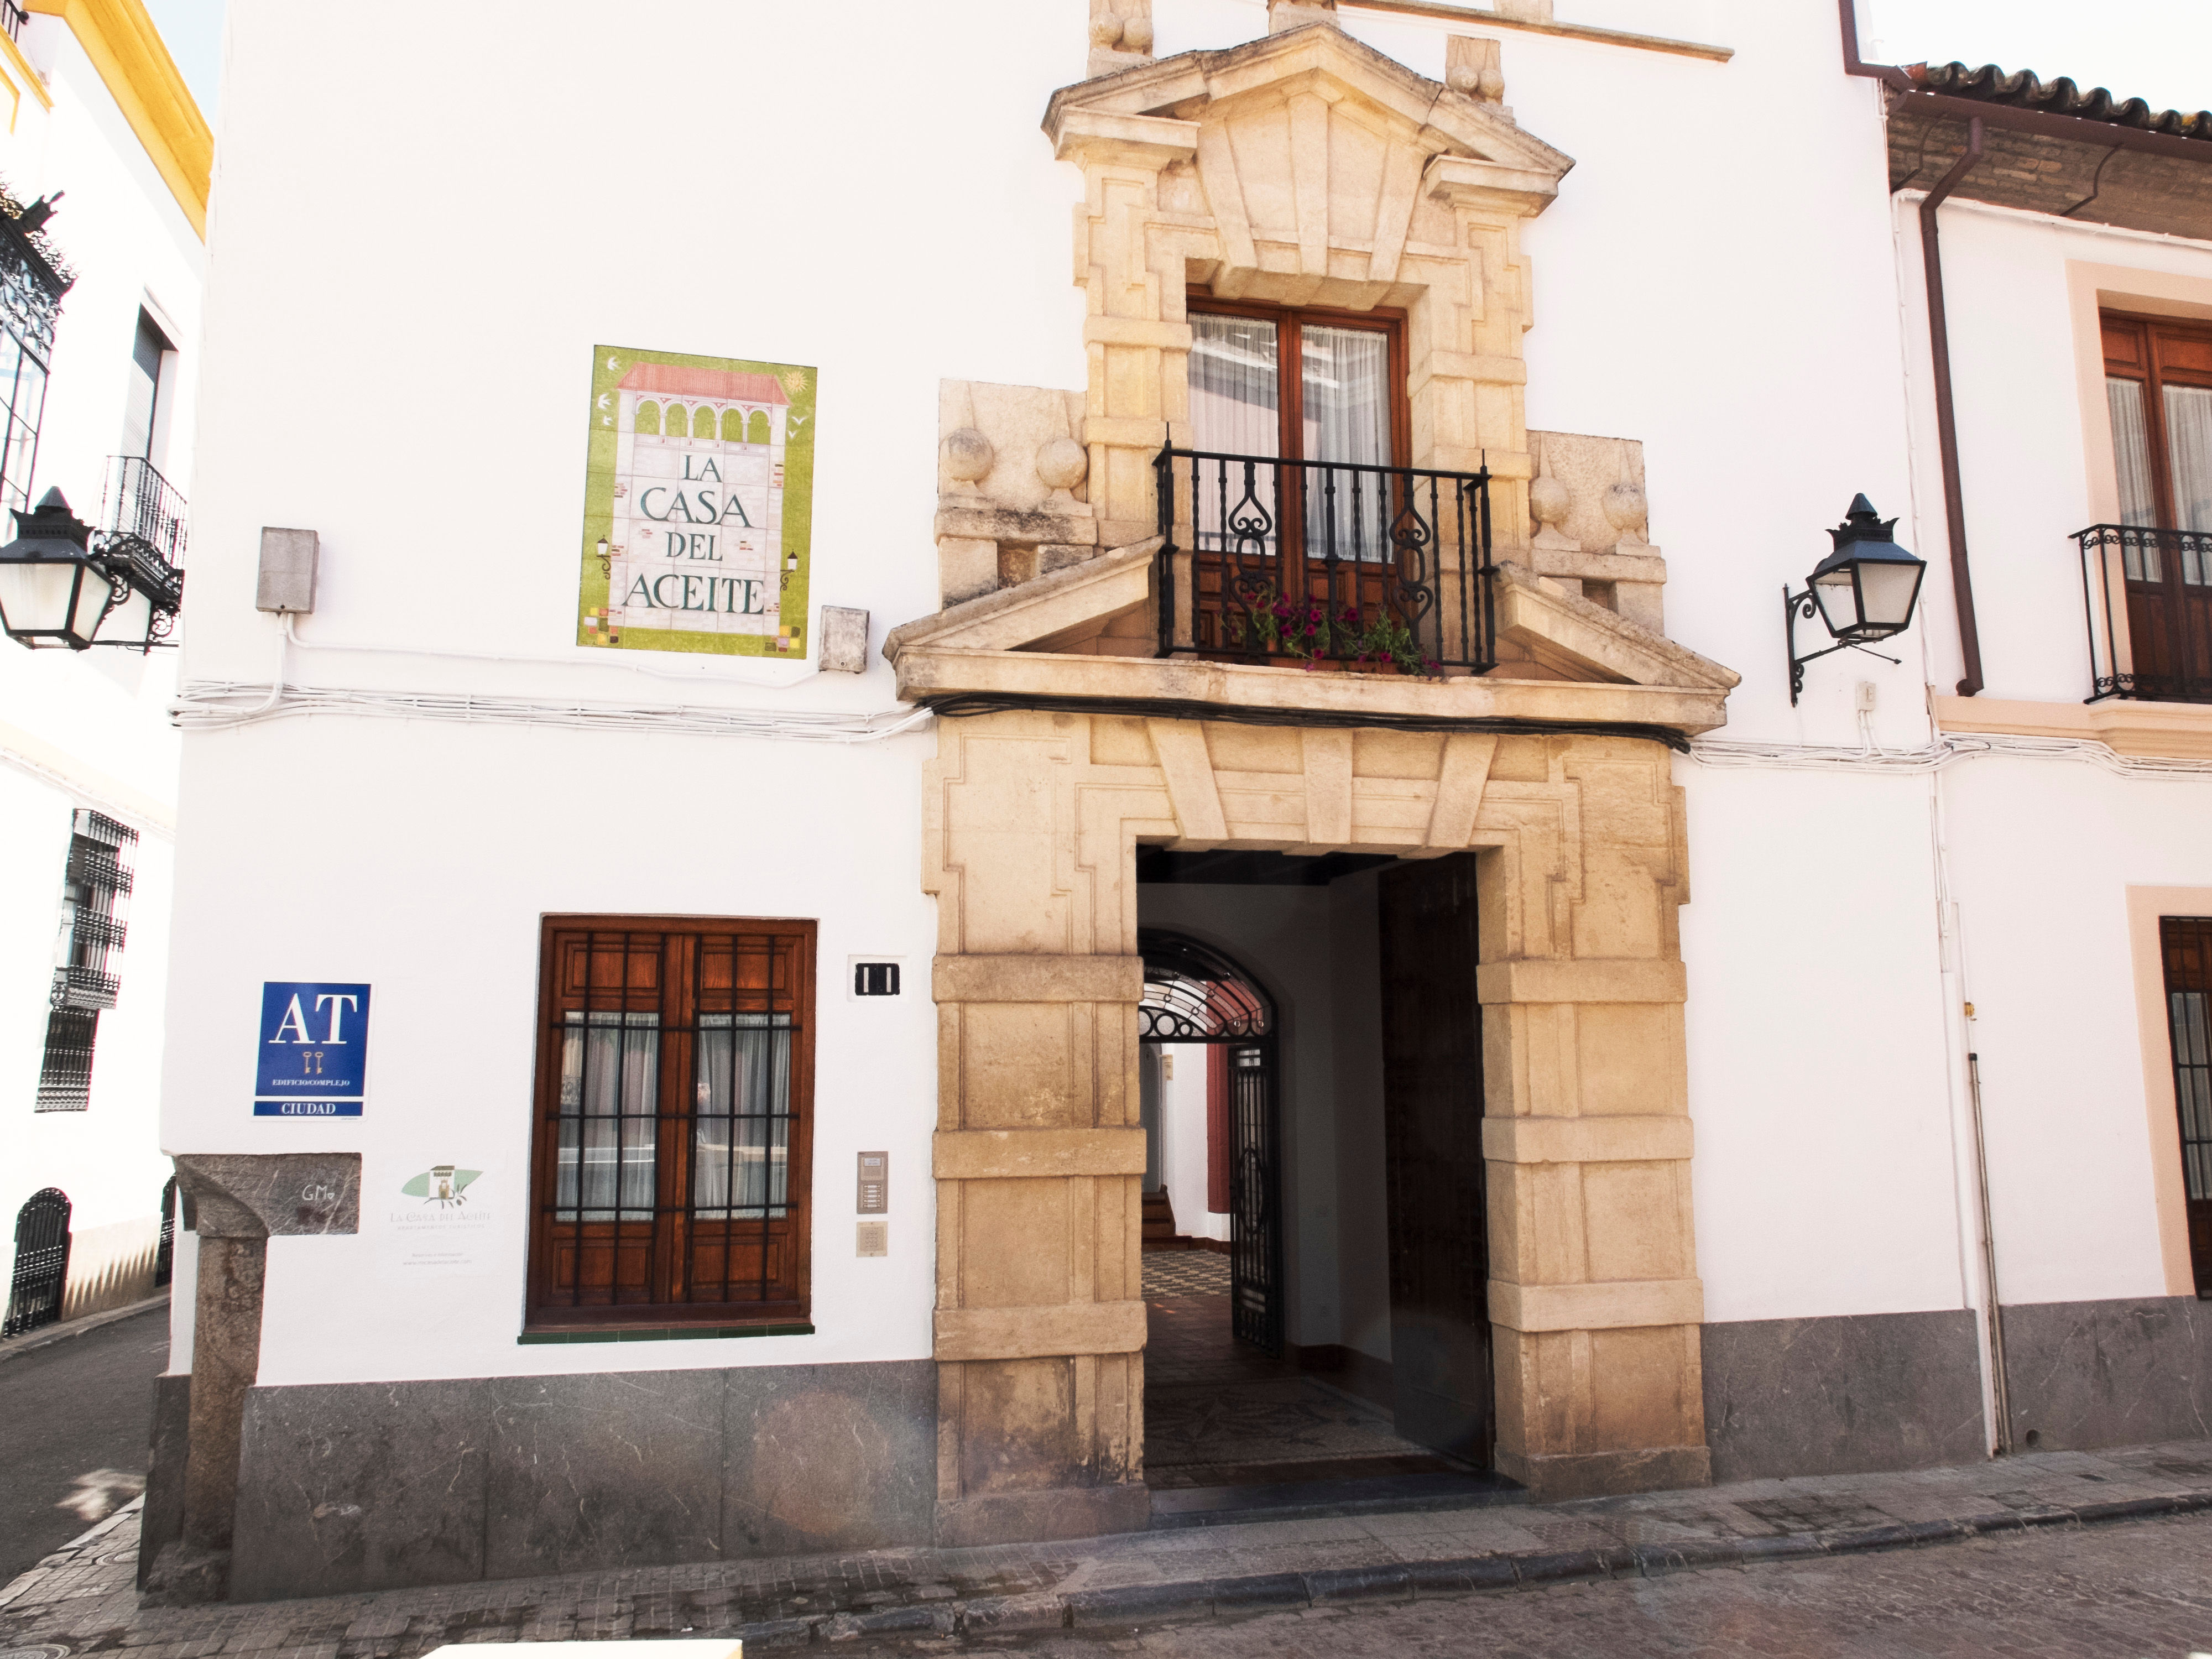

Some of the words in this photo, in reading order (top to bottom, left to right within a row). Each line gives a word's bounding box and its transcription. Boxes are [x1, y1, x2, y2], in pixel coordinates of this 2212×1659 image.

[681, 455, 722, 483] LA
[640, 487, 755, 528] CASA
[665, 531, 723, 561] DEL
[621, 573, 764, 614] ACEITE
[268, 993, 358, 1044] AT
[281, 1103, 336, 1114] CIUDAD
